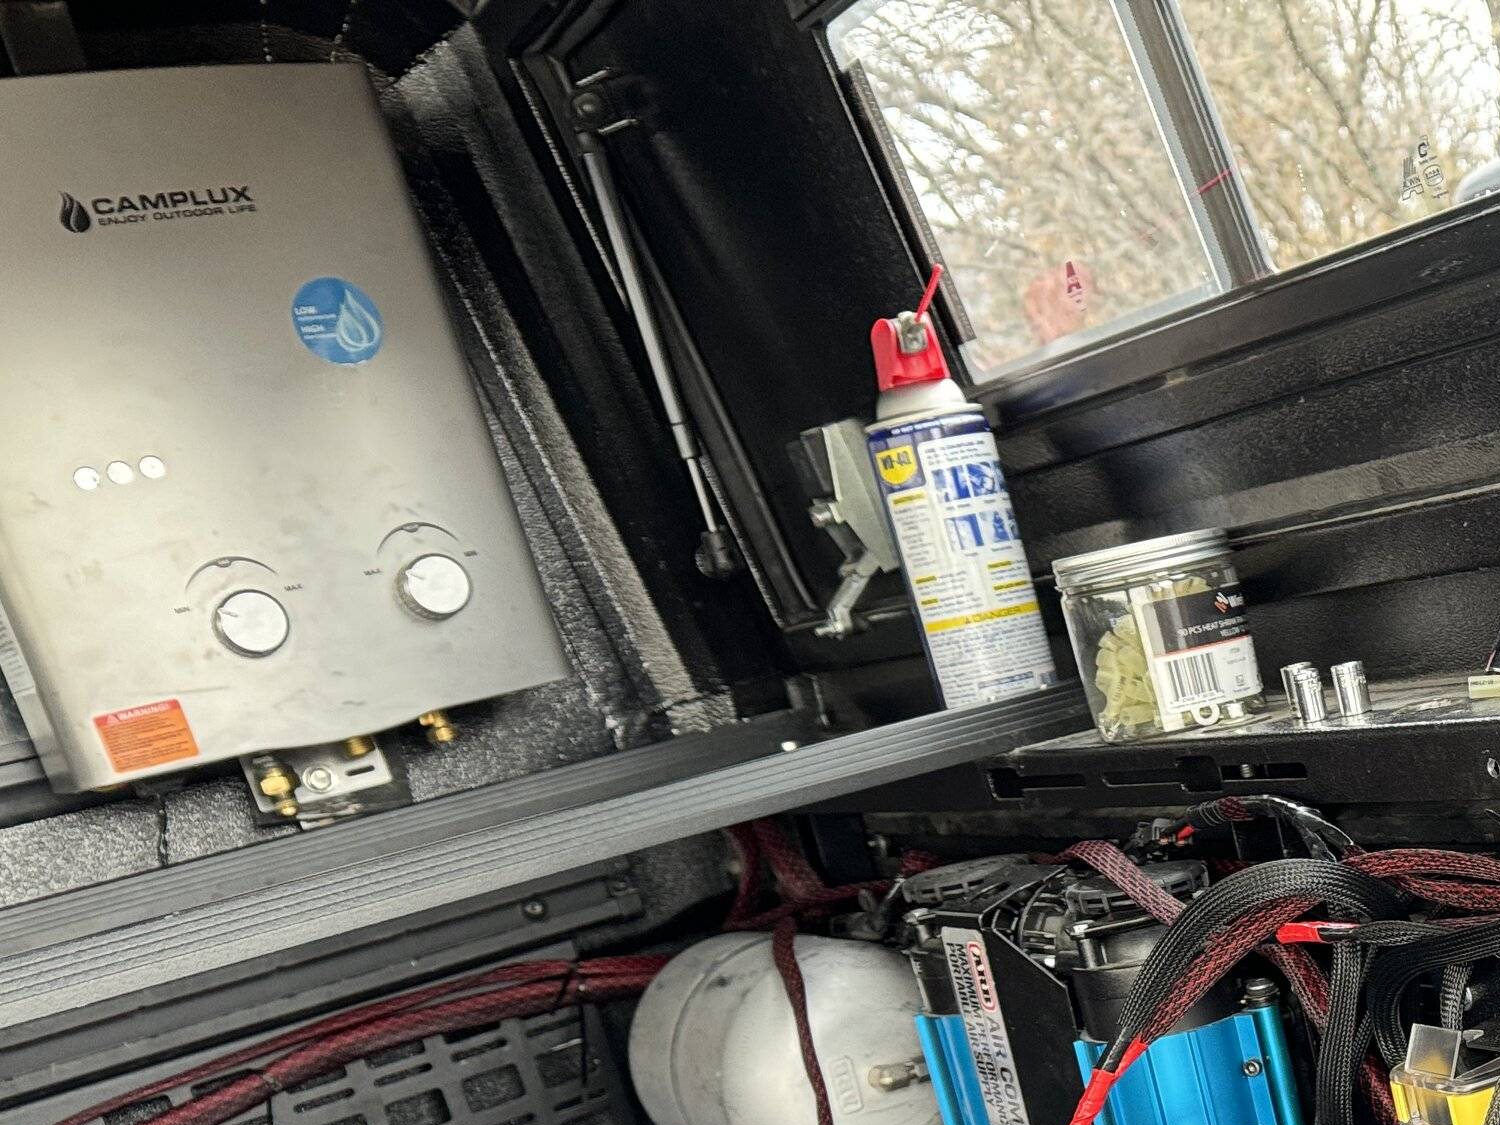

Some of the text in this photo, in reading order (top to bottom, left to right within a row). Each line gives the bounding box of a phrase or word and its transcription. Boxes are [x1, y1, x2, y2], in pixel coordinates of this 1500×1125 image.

[92, 186, 253, 214] CAMPLUX
[98, 204, 256, 225] ENJOY OUTDOOR LIFE
[955, 943, 982, 1019] MAXIMUM
[986, 1016, 1007, 1059] AIR
[974, 1050, 995, 1107] SUPPLY
